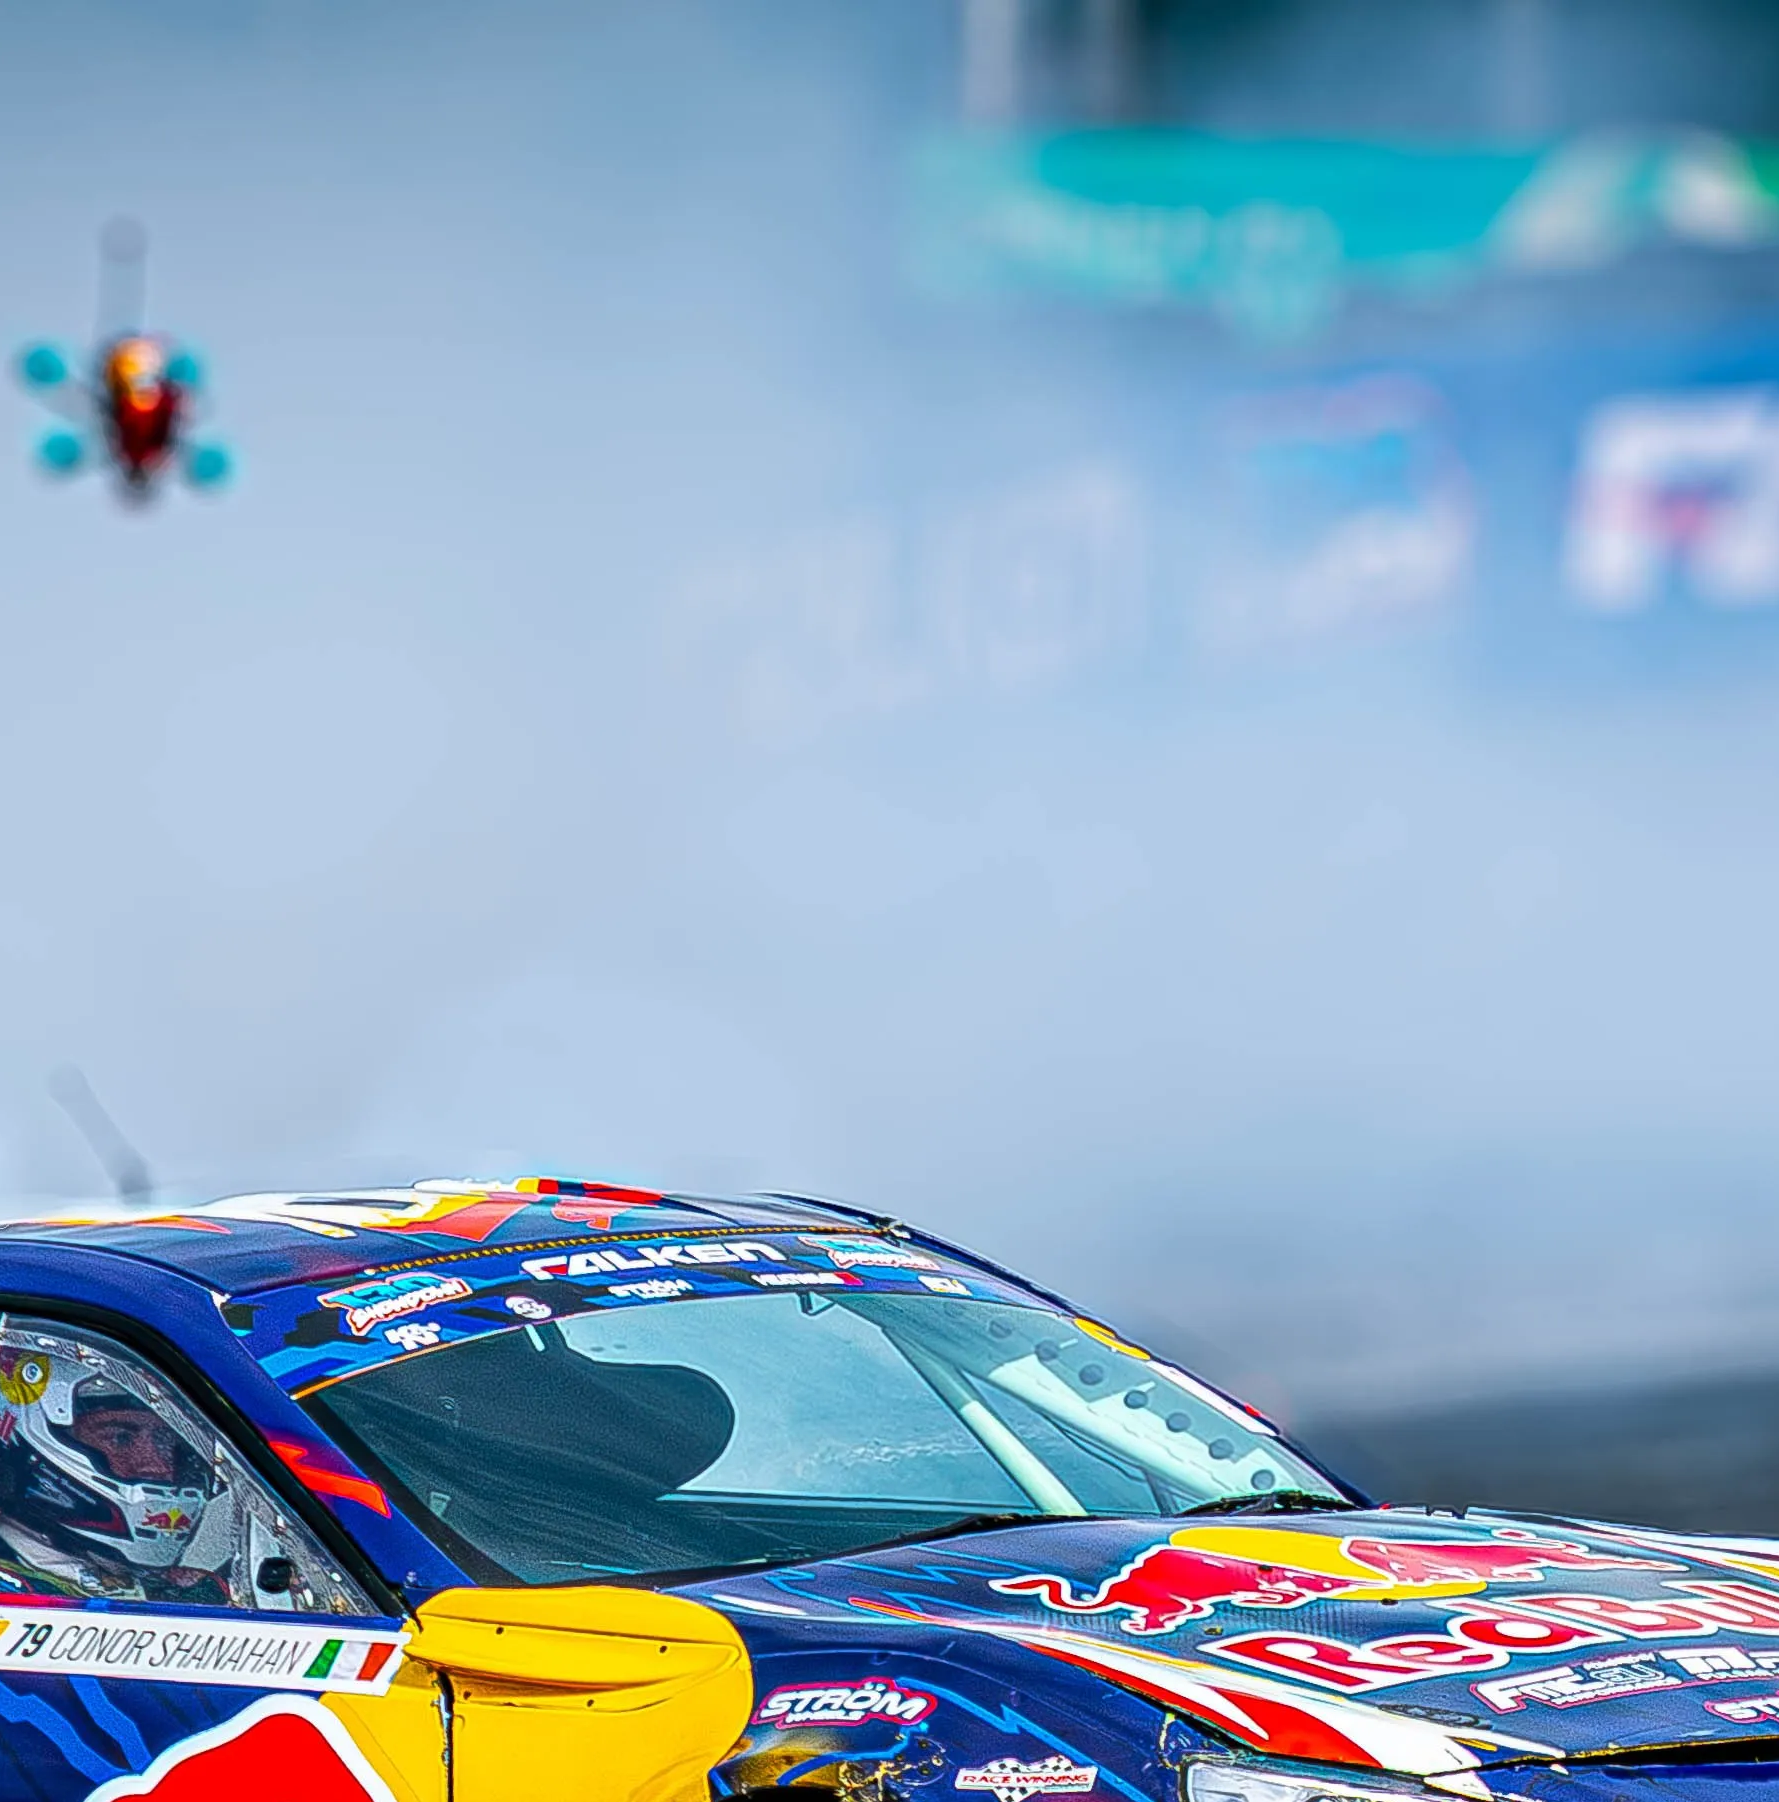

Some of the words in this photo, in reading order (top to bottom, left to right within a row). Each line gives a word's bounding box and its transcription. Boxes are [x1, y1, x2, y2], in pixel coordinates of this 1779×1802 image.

[522, 1242, 787, 1280] FALKEN
[6, 1623, 53, 1657] 79
[49, 1625, 155, 1666] CONOR
[149, 1632, 312, 1676] SHANAHAN
[761, 1682, 928, 1720] STRÖM
[963, 1774, 1010, 1785] RACE
[1016, 1773, 1090, 1785] WINNING
